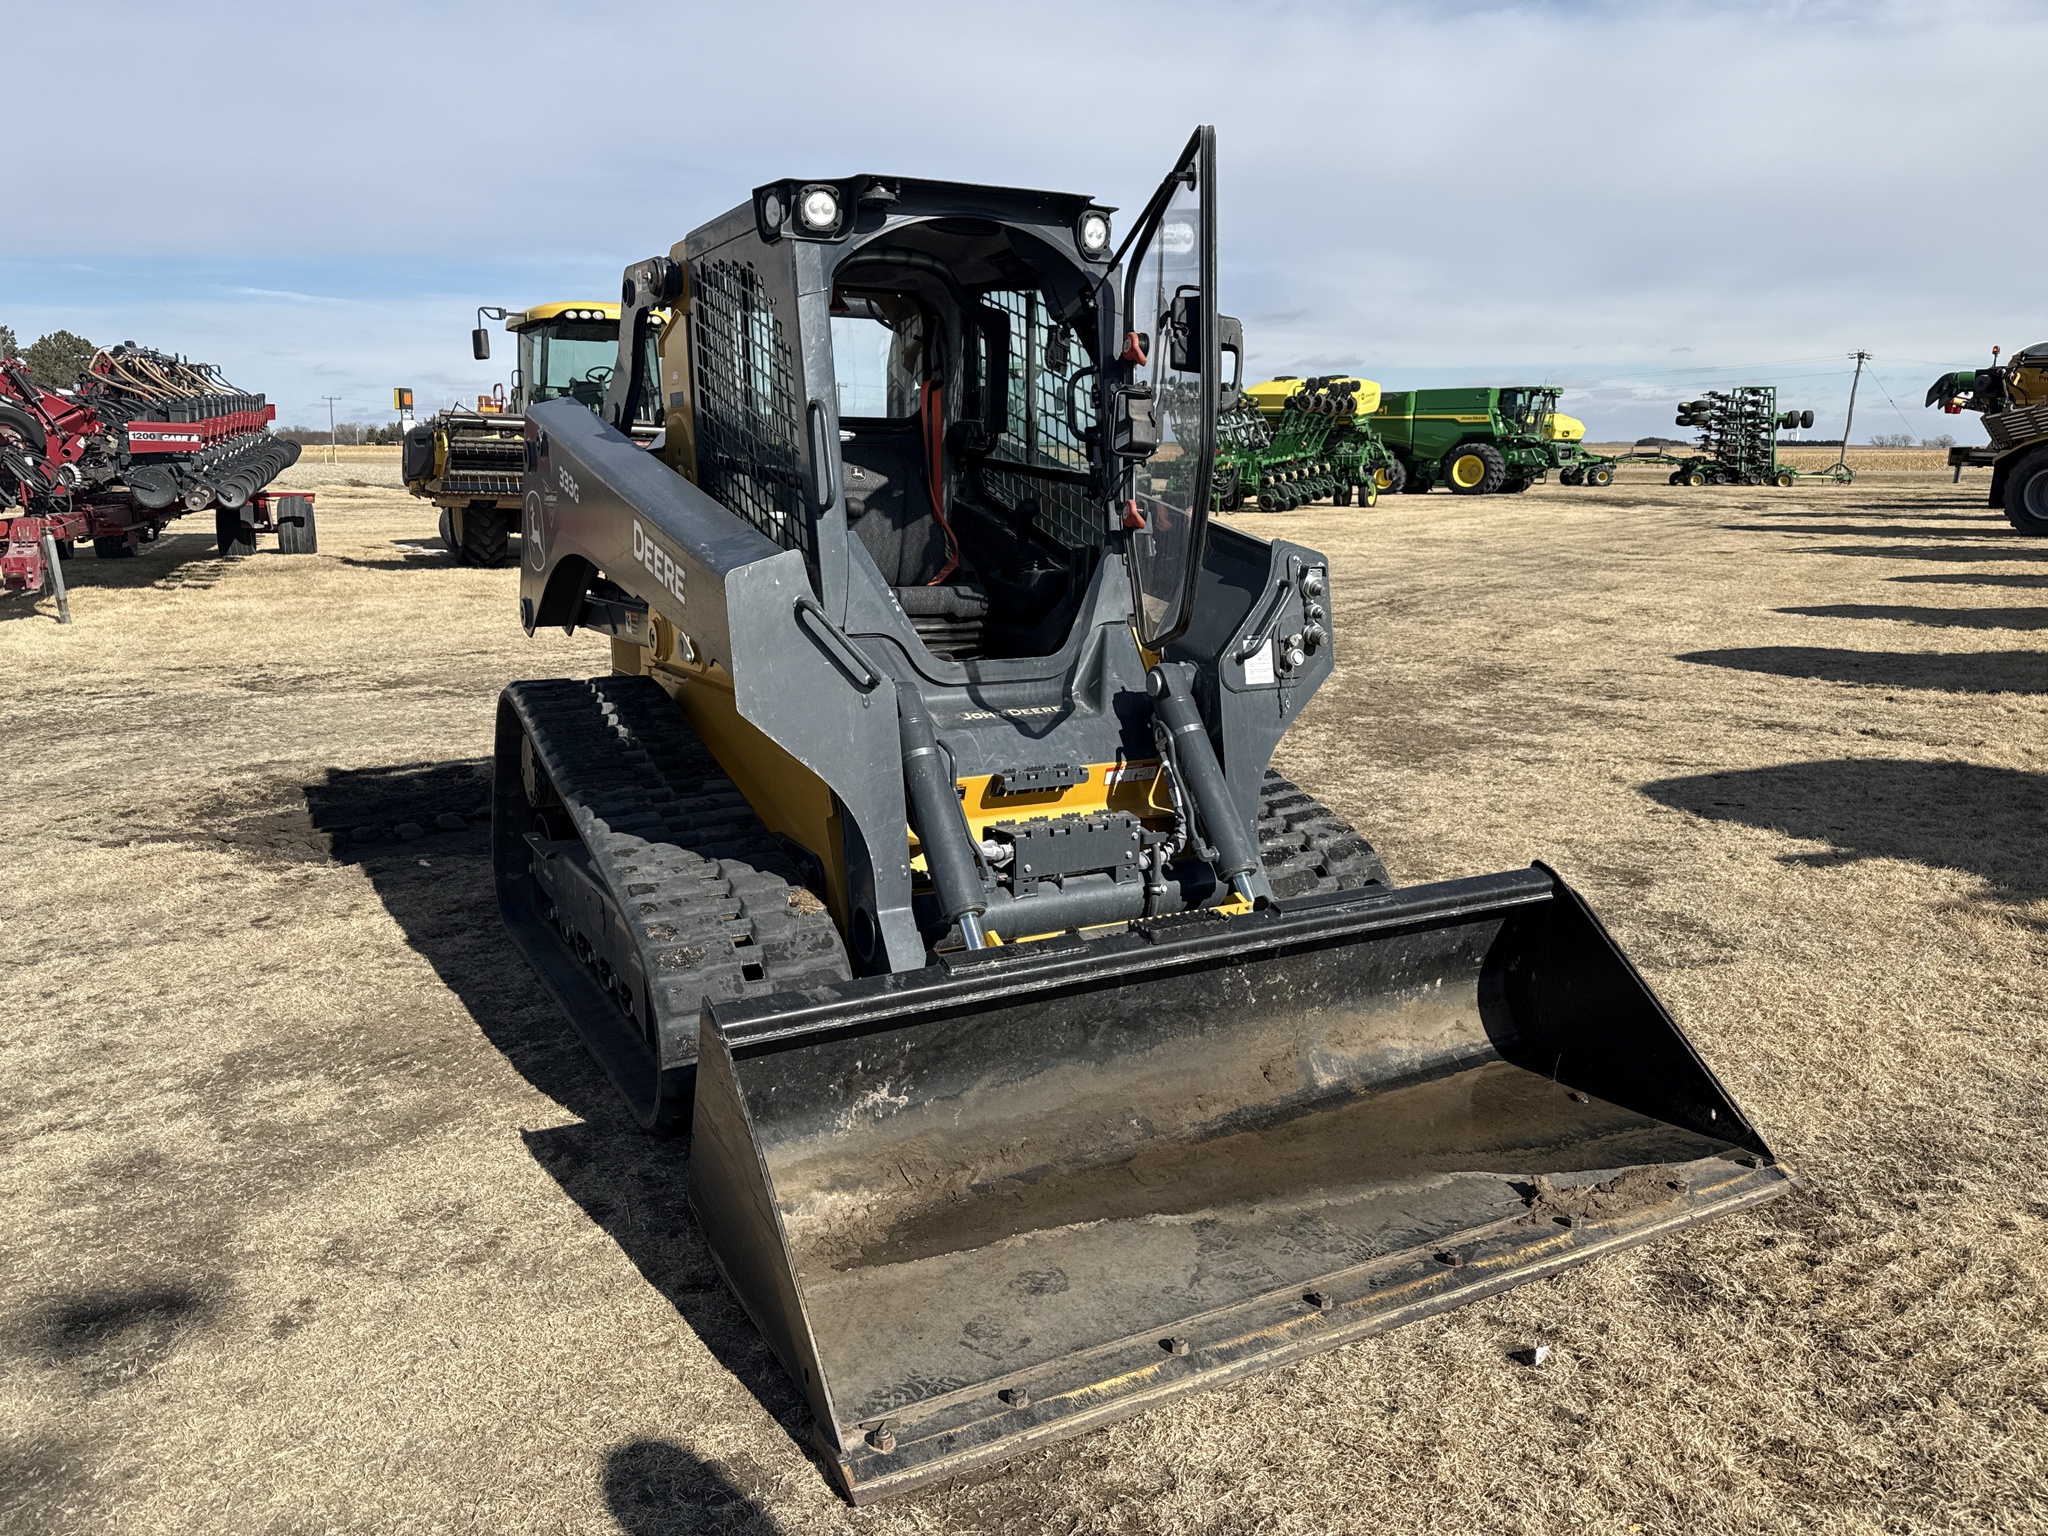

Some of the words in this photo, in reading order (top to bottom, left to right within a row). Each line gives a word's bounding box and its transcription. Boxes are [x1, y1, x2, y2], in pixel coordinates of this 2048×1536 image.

[131, 432, 156, 440] 1200
[161, 434, 189, 442] CASE
[558, 465, 580, 504] 333G
[633, 518, 686, 605] DEERE
